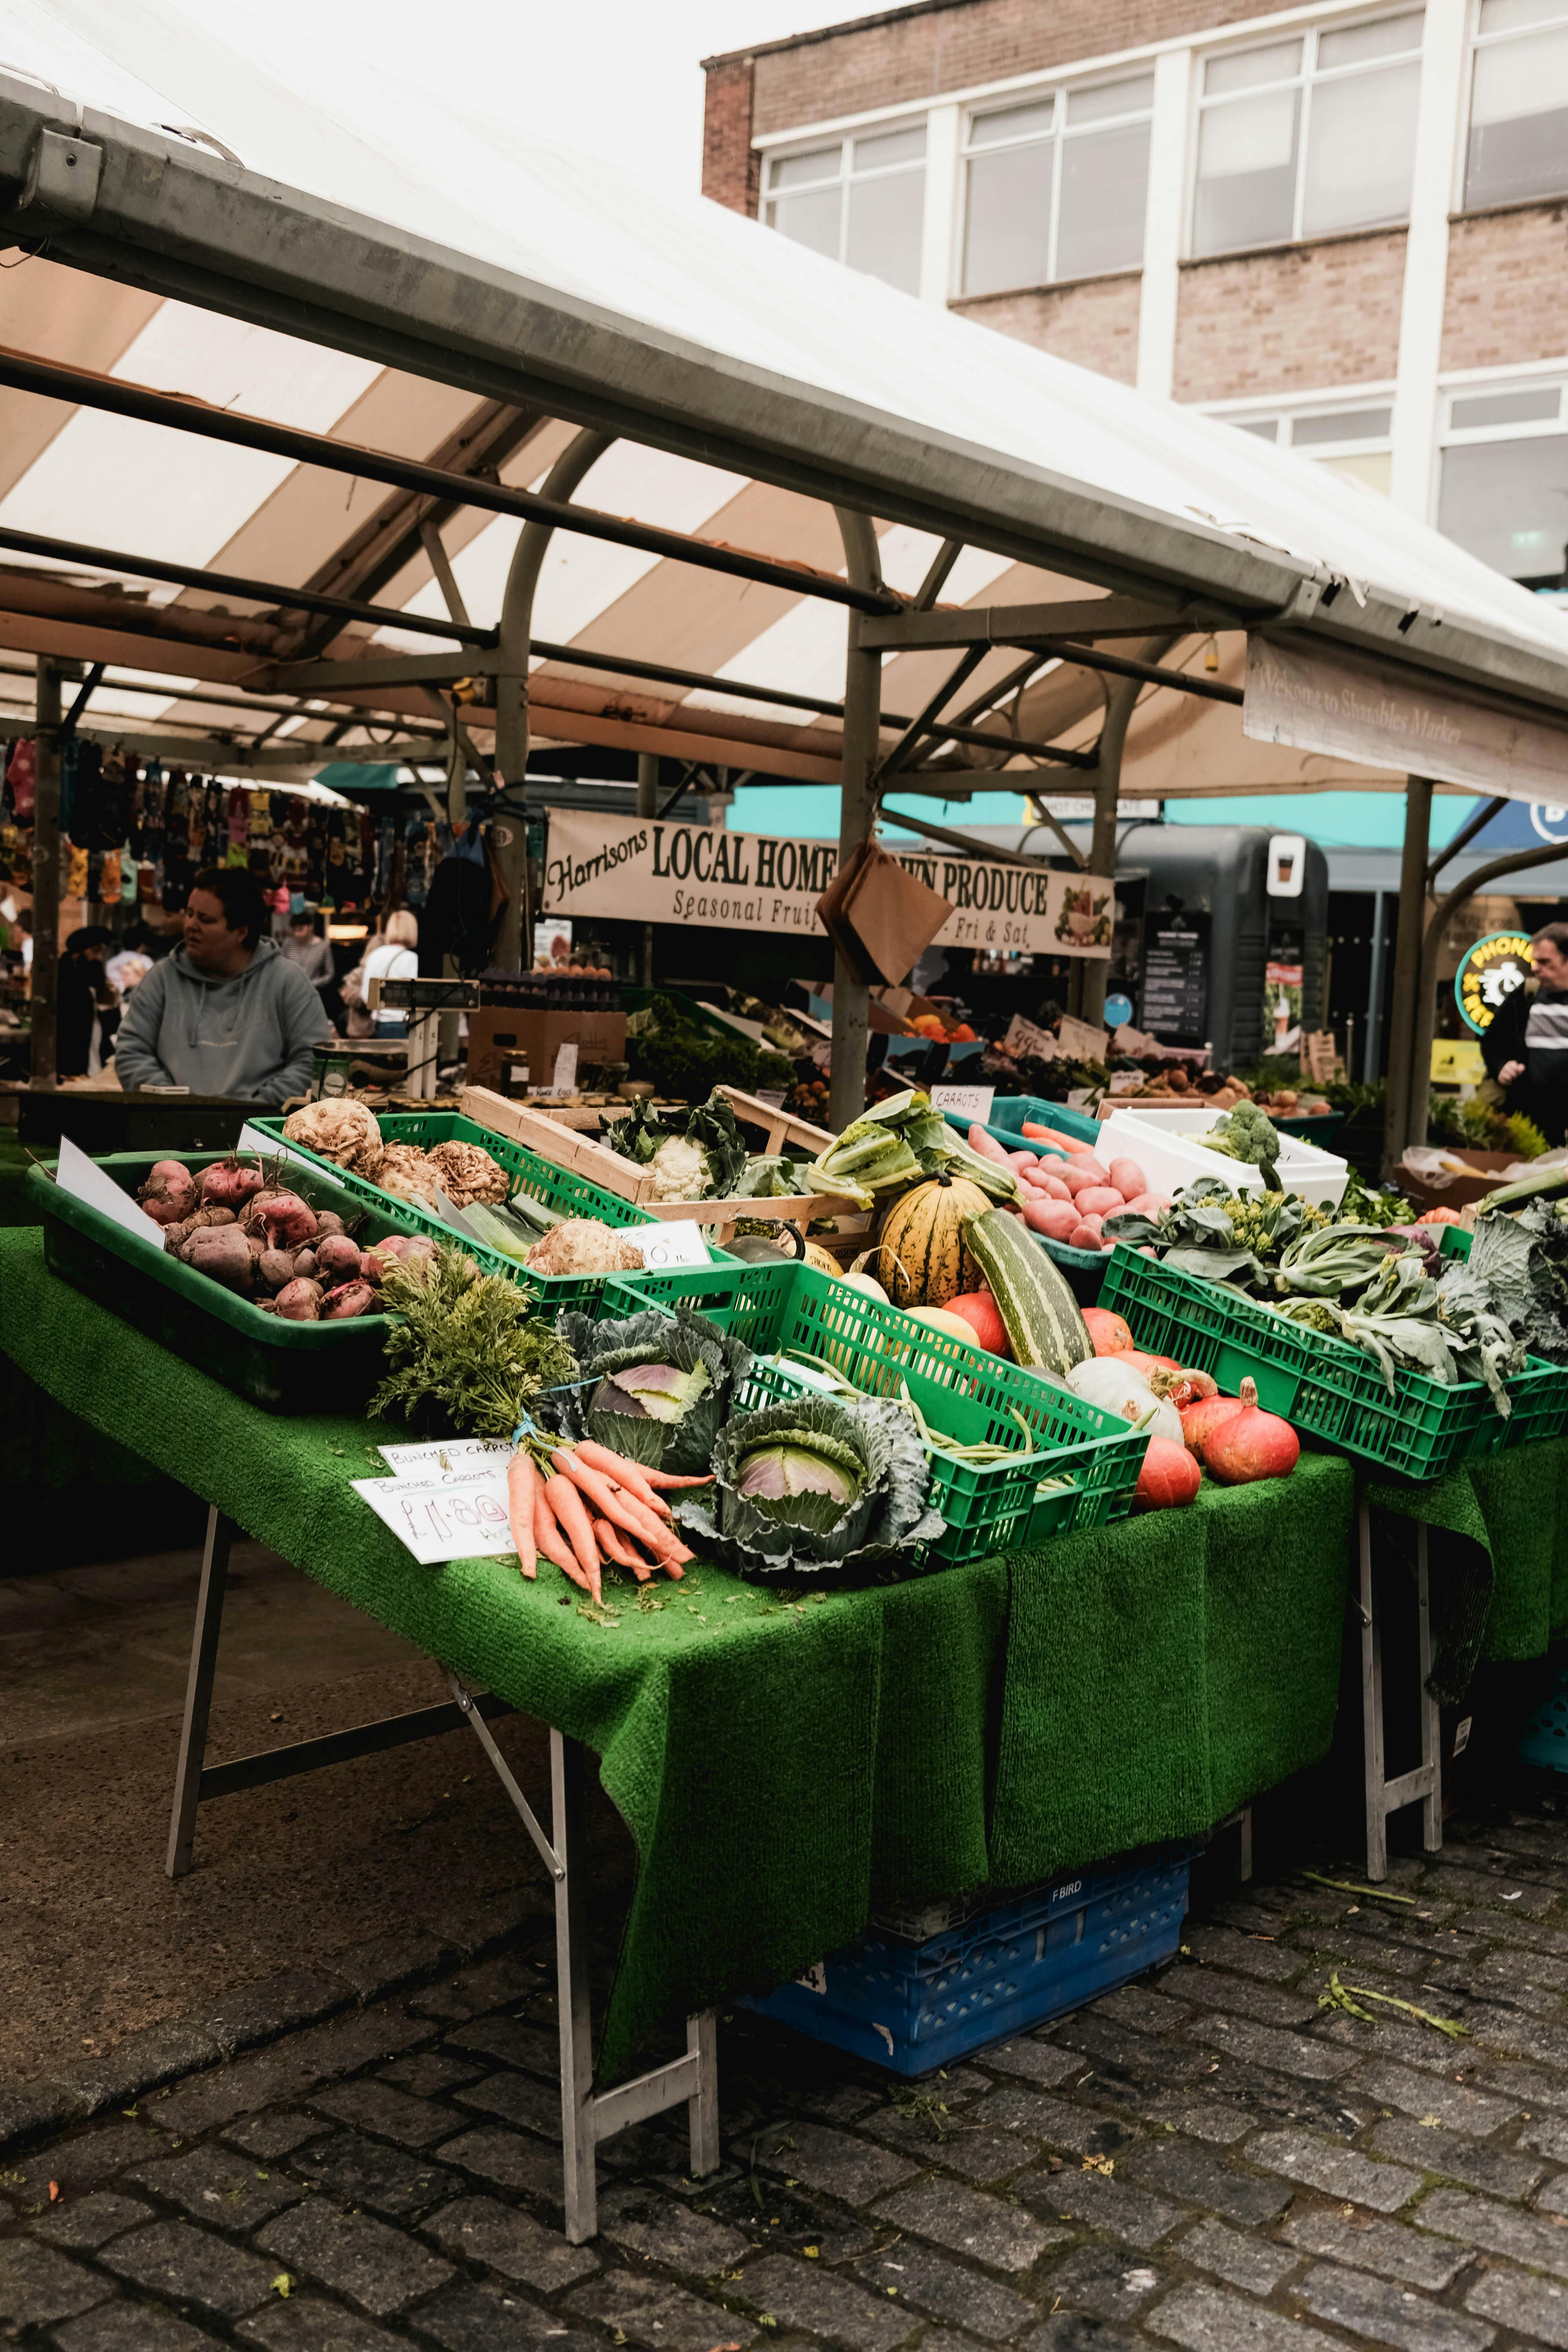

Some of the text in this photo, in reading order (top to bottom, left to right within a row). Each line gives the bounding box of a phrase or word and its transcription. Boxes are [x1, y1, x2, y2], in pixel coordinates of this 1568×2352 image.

[1325, 689, 1338, 715] to
[1410, 708, 1461, 746] Market
[548, 829, 647, 902] Harrisons
[652, 826, 749, 886] LOCAL
[944, 862, 1048, 915] PRODUCE
[673, 889, 762, 921] Seasonal
[955, 917, 978, 940] Fri
[986, 921, 996, 942] &
[1004, 920, 1029, 944] Sat
[936, 1092, 980, 1108] CARROTS
[391, 1448, 461, 1465] BUNCHED
[1052, 1880, 1082, 1902] F BIRD
